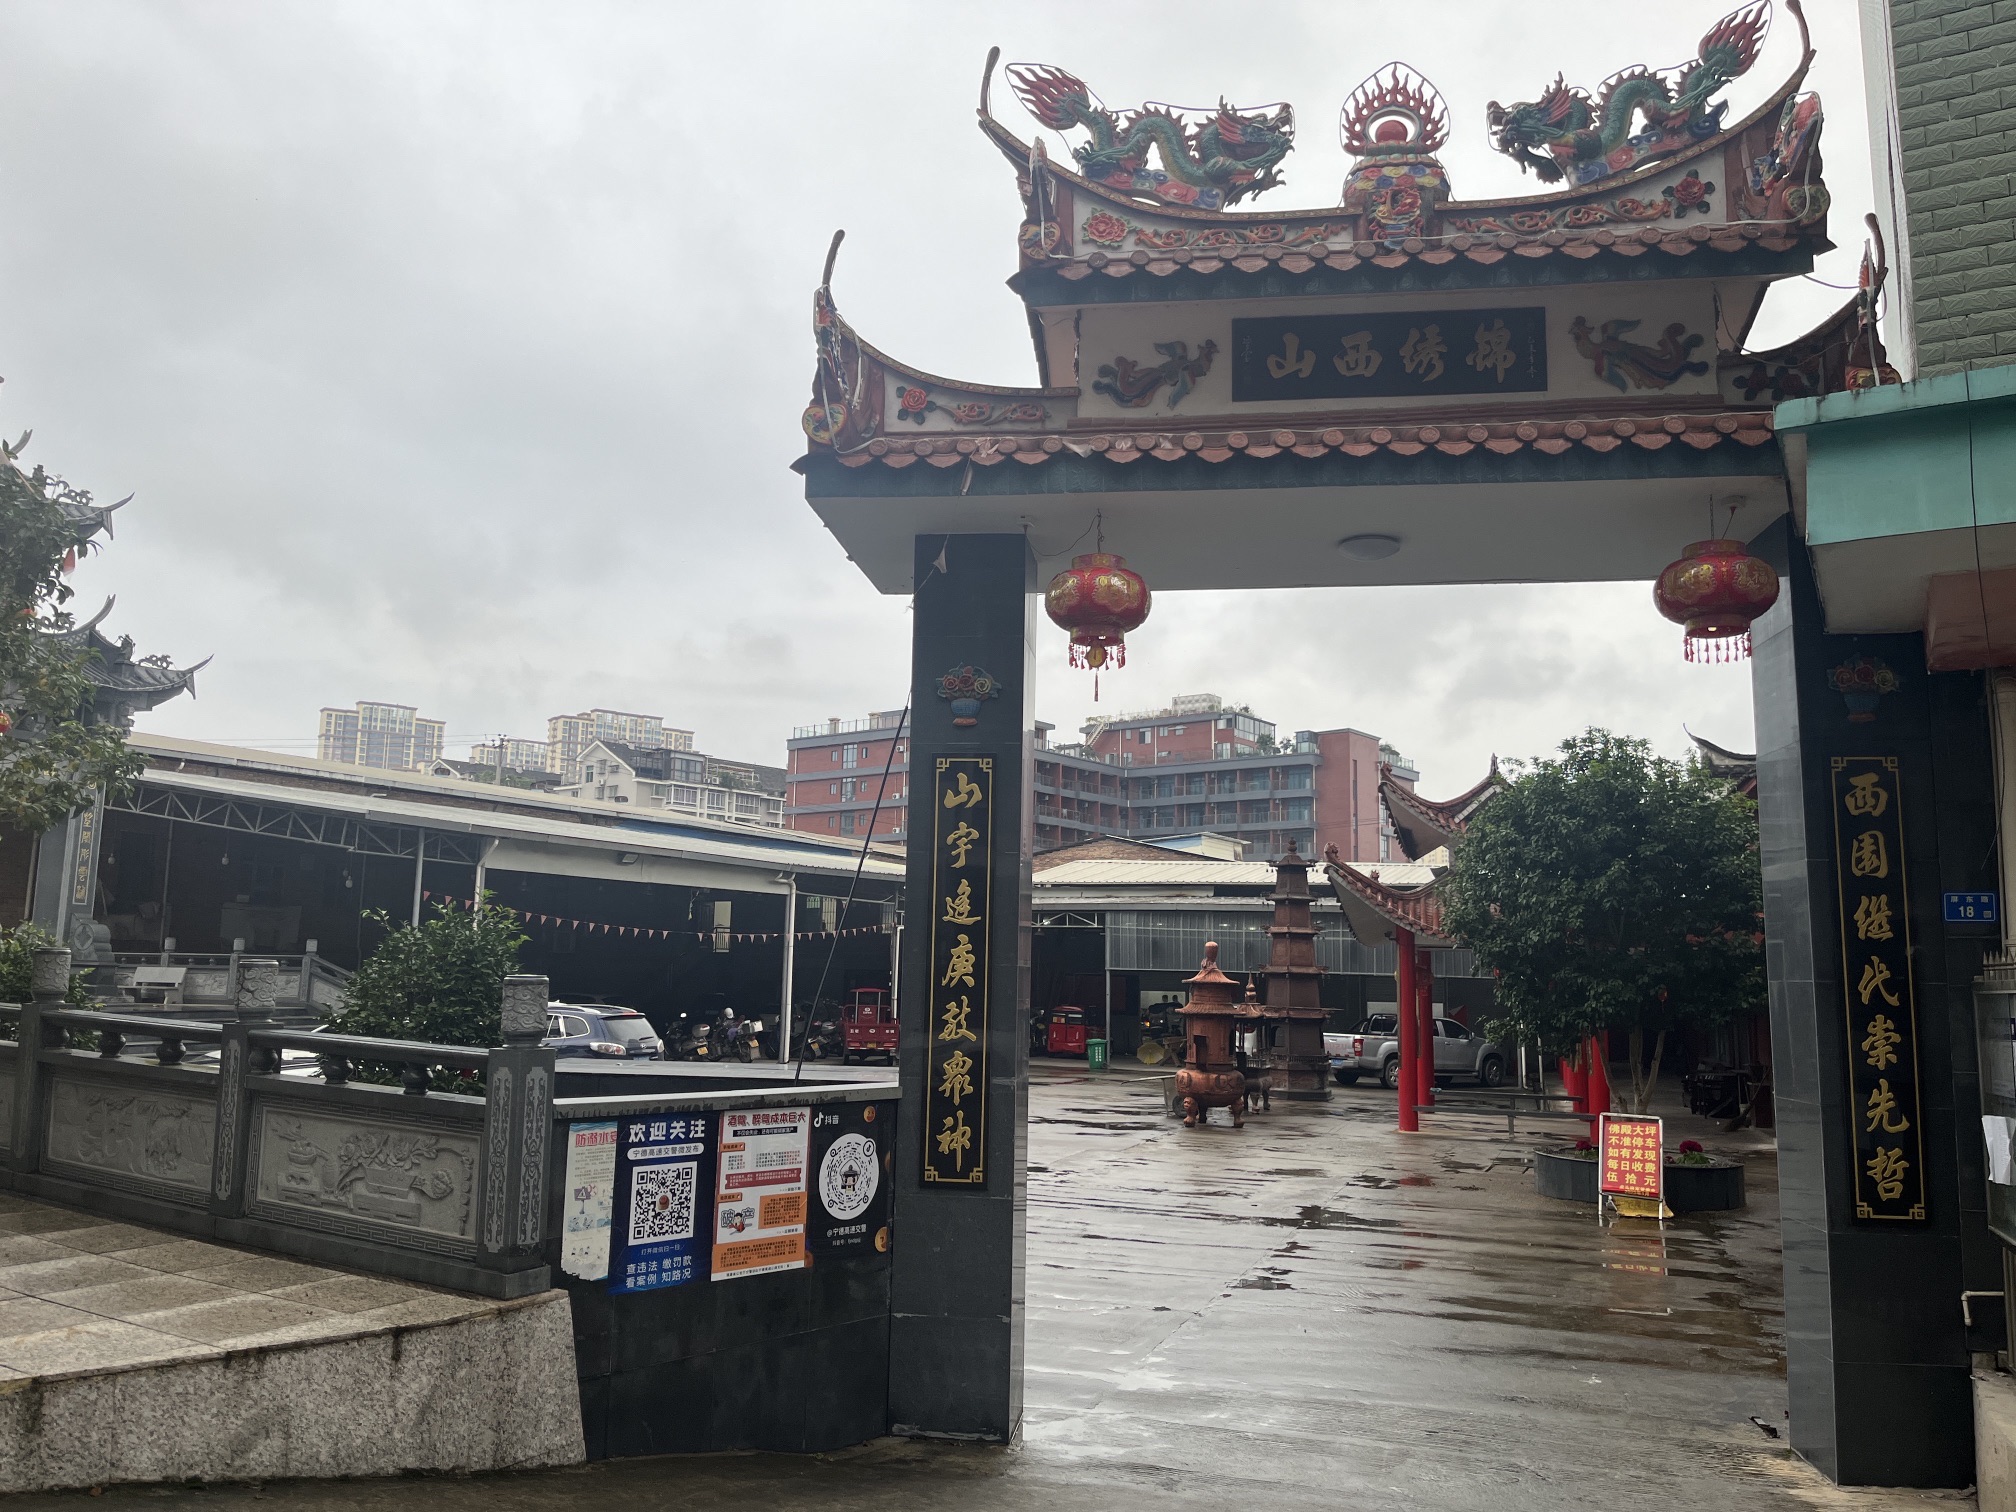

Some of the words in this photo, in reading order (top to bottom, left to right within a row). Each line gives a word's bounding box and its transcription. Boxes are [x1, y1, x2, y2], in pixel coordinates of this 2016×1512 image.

[1959, 905, 1974, 918] 18
[824, 1114, 839, 1125] 抖音
[628, 1118, 706, 1143] 欢迎关注
[1608, 1123, 1657, 1137] 佛殿大坪
[1608, 1135, 1656, 1148] 不准停车
[1607, 1147, 1656, 1161] 如有发现
[1607, 1158, 1656, 1174] 每日收费
[1606, 1171, 1656, 1187] 伍拾元
[626, 1260, 658, 1275] 查违法
[662, 1255, 692, 1270] 缴罚款
[626, 1273, 657, 1289] 看案例
[661, 1267, 691, 1283] 知路况
